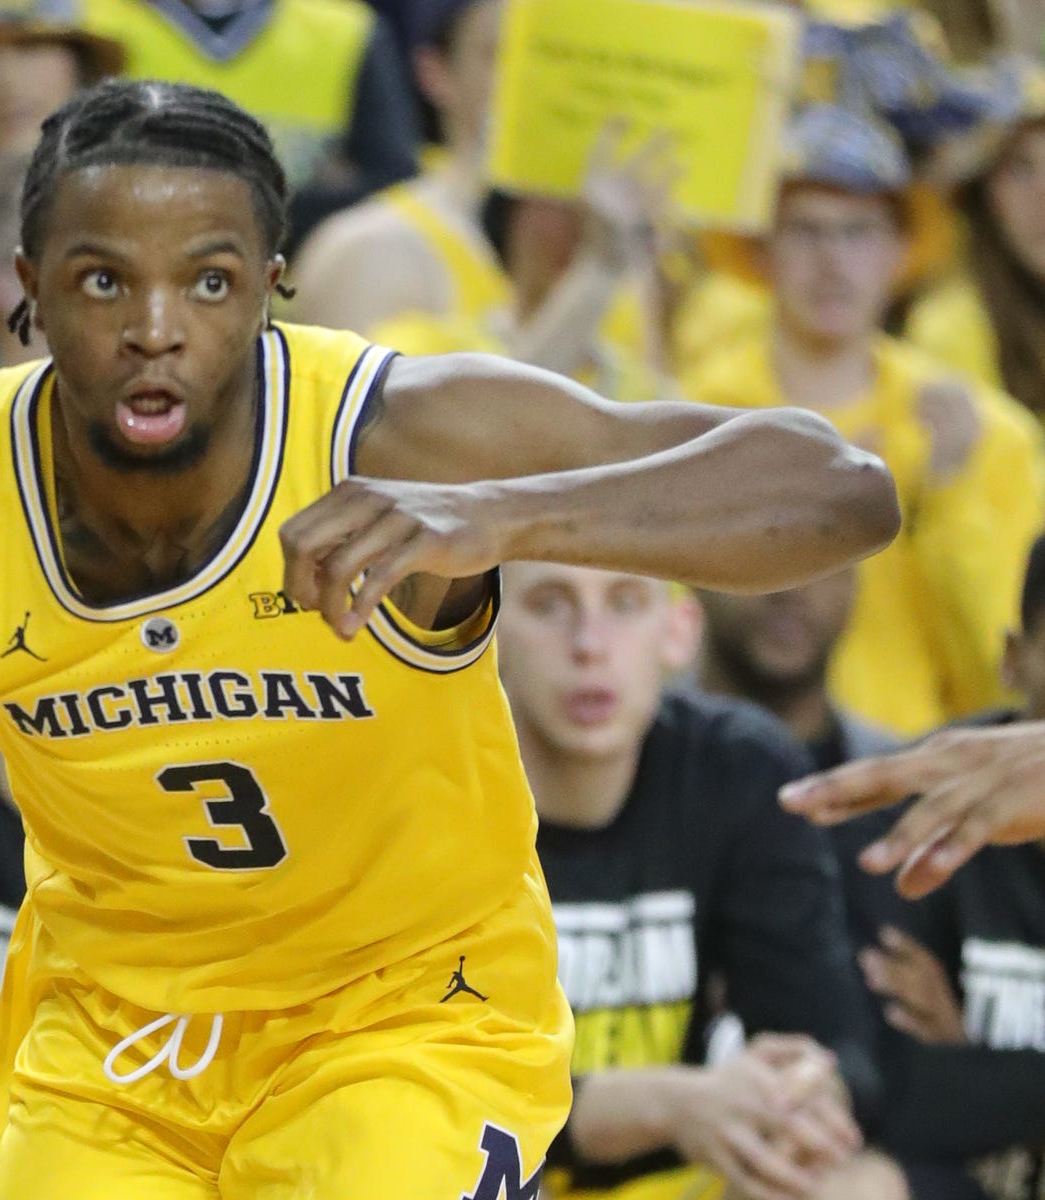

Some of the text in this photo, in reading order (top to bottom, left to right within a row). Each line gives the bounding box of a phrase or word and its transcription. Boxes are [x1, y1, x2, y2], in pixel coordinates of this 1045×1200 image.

[146, 626, 176, 646] M
[4, 670, 375, 738] MICHIGAN
[155, 761, 289, 872] 3
